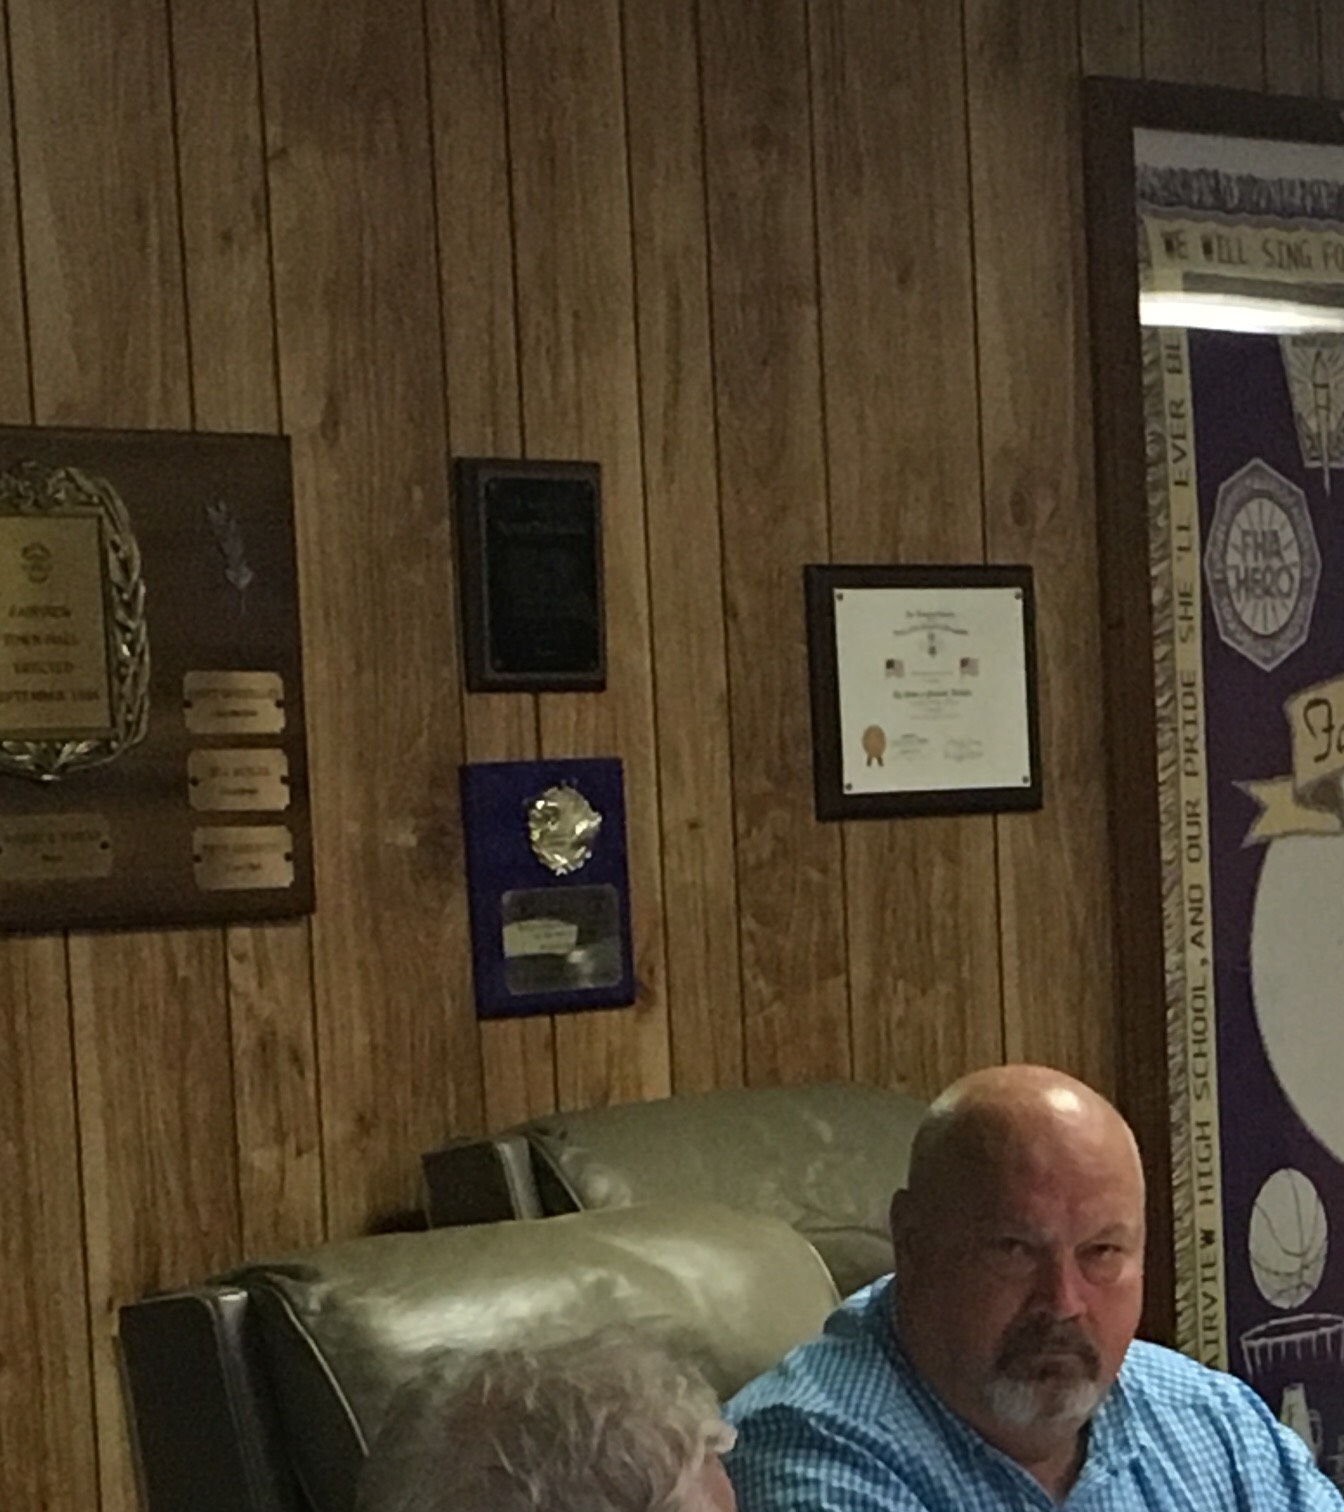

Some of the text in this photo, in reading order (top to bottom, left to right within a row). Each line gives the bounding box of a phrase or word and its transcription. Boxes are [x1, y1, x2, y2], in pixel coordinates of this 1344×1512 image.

[1160, 228, 1189, 260] WE
[1201, 233, 1248, 266] WILL
[1262, 238, 1313, 270] SING
[1169, 400, 1189, 487] EVER
[1181, 669, 1199, 777] PRIDE
[1185, 799, 1202, 863] OUR
[1195, 1121, 1214, 1206] HIGH
[1199, 1228, 1220, 1369] AIRVIEW
